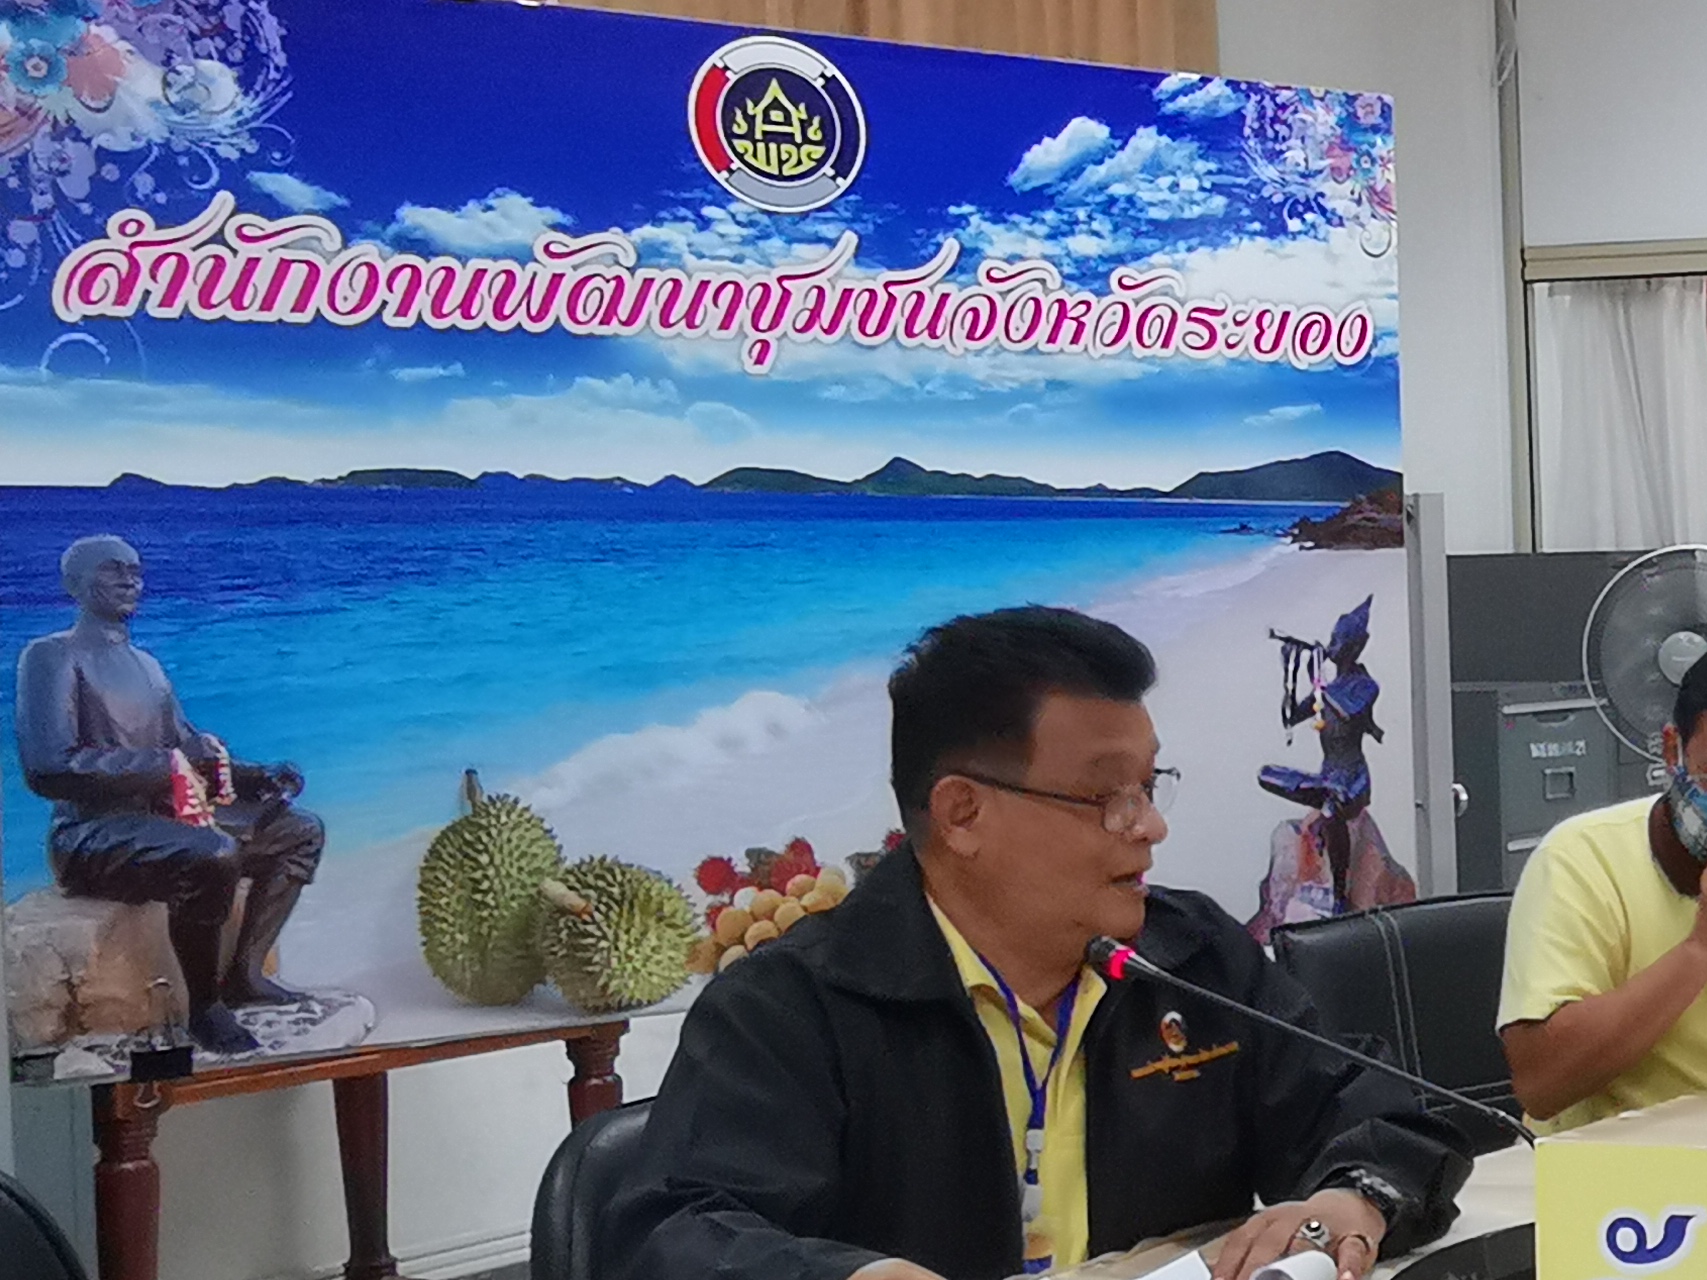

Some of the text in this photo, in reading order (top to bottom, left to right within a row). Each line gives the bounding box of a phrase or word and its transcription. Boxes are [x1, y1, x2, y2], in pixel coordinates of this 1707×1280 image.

[57, 190, 1373, 373] สำนักงานพัฒนาชุมชนจังหวัดระยอง
